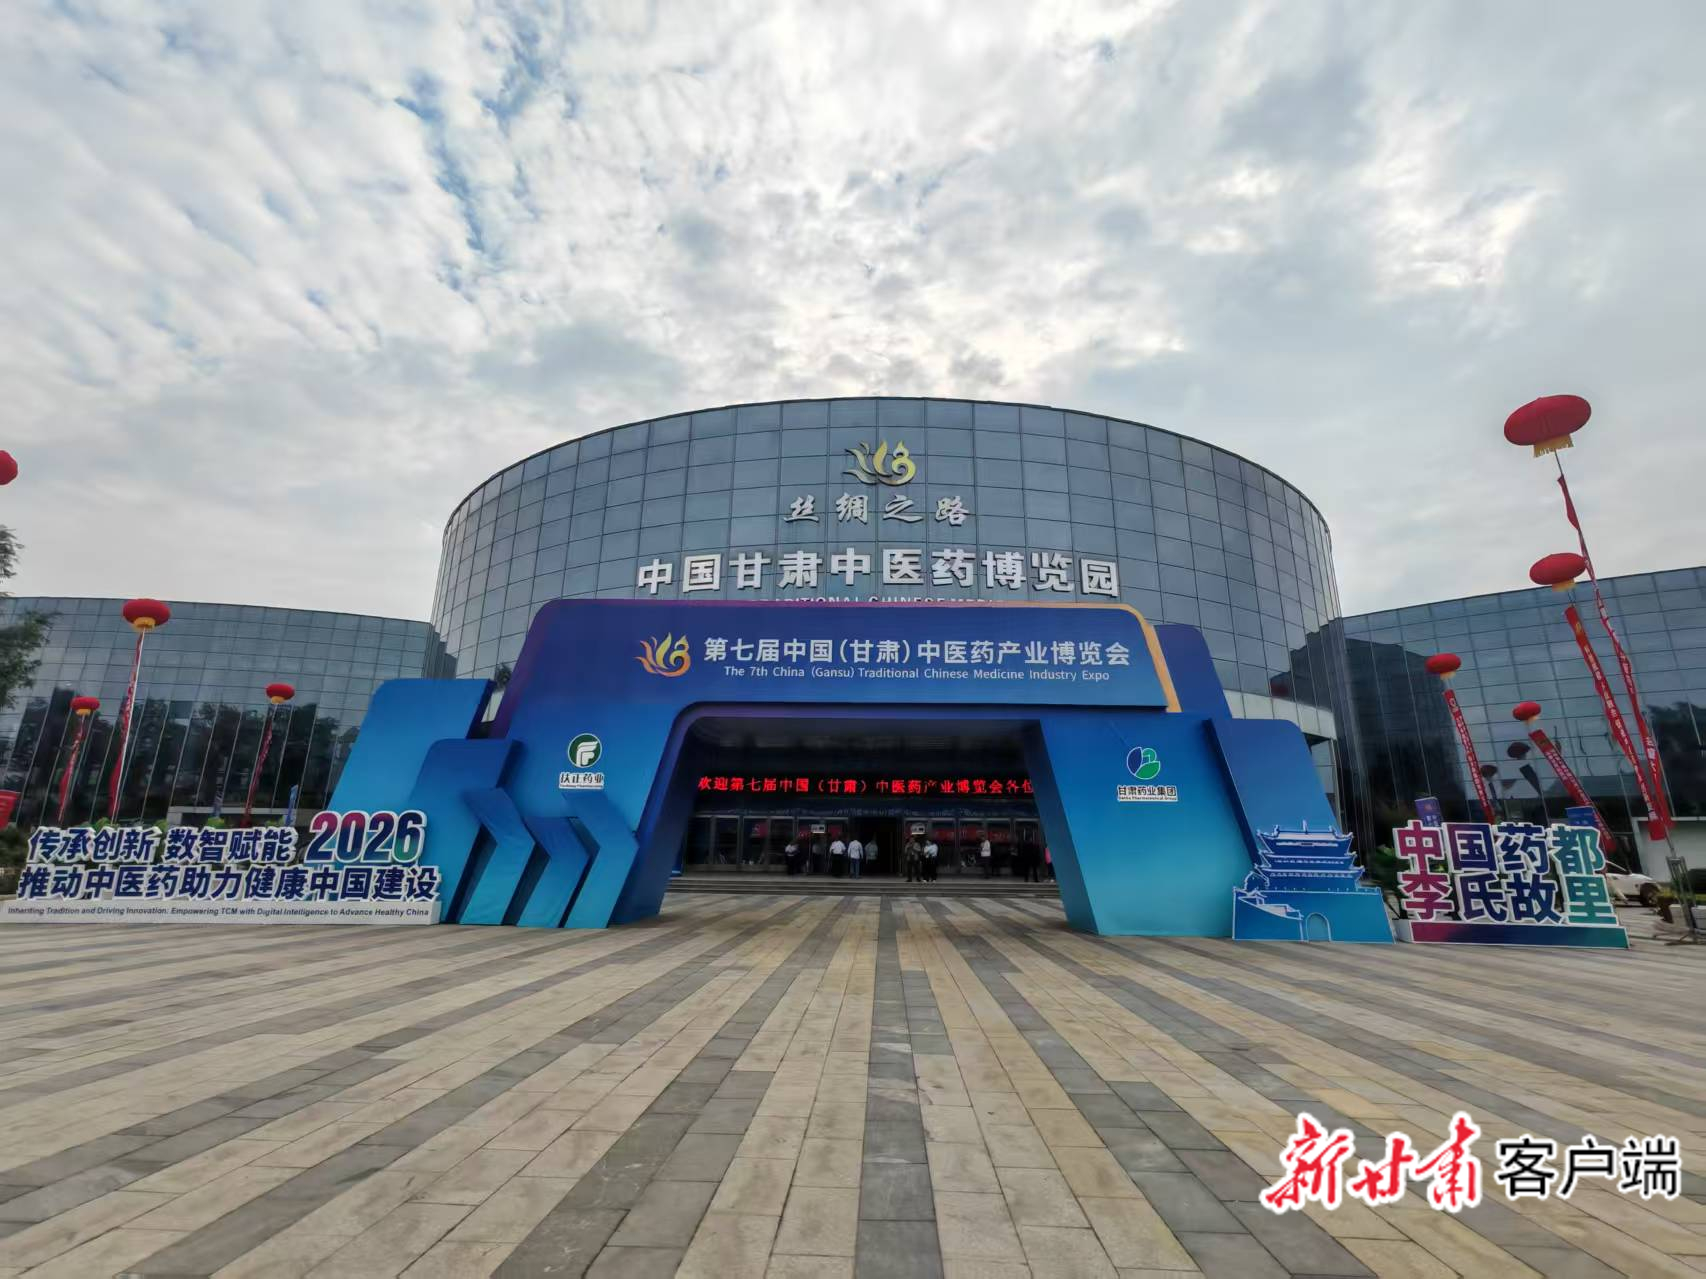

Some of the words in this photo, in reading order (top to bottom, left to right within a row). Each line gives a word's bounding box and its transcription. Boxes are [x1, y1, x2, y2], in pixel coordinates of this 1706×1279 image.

[783, 493, 972, 526] 丝绸之路
[637, 548, 1120, 598] 中国甘肃中医药博览园
[703, 637, 1130, 665] 第七届中国（甘肃）中医药产业博览会
[724, 666, 745, 676] The
[750, 666, 768, 677] 7th
[773, 666, 805, 677] China
[811, 666, 855, 679] (Gansu)
[859, 667, 919, 678] Traditional
[924, 668, 968, 679] Chinese
[974, 669, 1024, 680] Medicine
[1030, 670, 1076, 682] Industry
[1082, 670, 1110, 682] Expo
[28, 828, 157, 863] 传承创新
[165, 828, 296, 863] 数智赋能
[306, 811, 425, 864] 2026
[1395, 820, 1605, 875] 中国药都
[18, 865, 440, 901] 推动中医药助力健康中国建设
[1397, 872, 1619, 926] 李氏故里
[8, 906, 44, 916] Inheriting
[47, 906, 80, 915] Tradition
[82, 907, 96, 915] and
[98, 907, 125, 916] Driving
[170, 907, 219, 916] Empowering
[221, 907, 237, 915] TCM
[239, 907, 255, 915] with
[257, 907, 283, 917] Digital
[284, 908, 328, 917] Intelligence
[330, 908, 338, 916] to
[339, 908, 373, 916] Advance
[375, 908, 404, 917] Healthy
[406, 908, 429, 916] China
